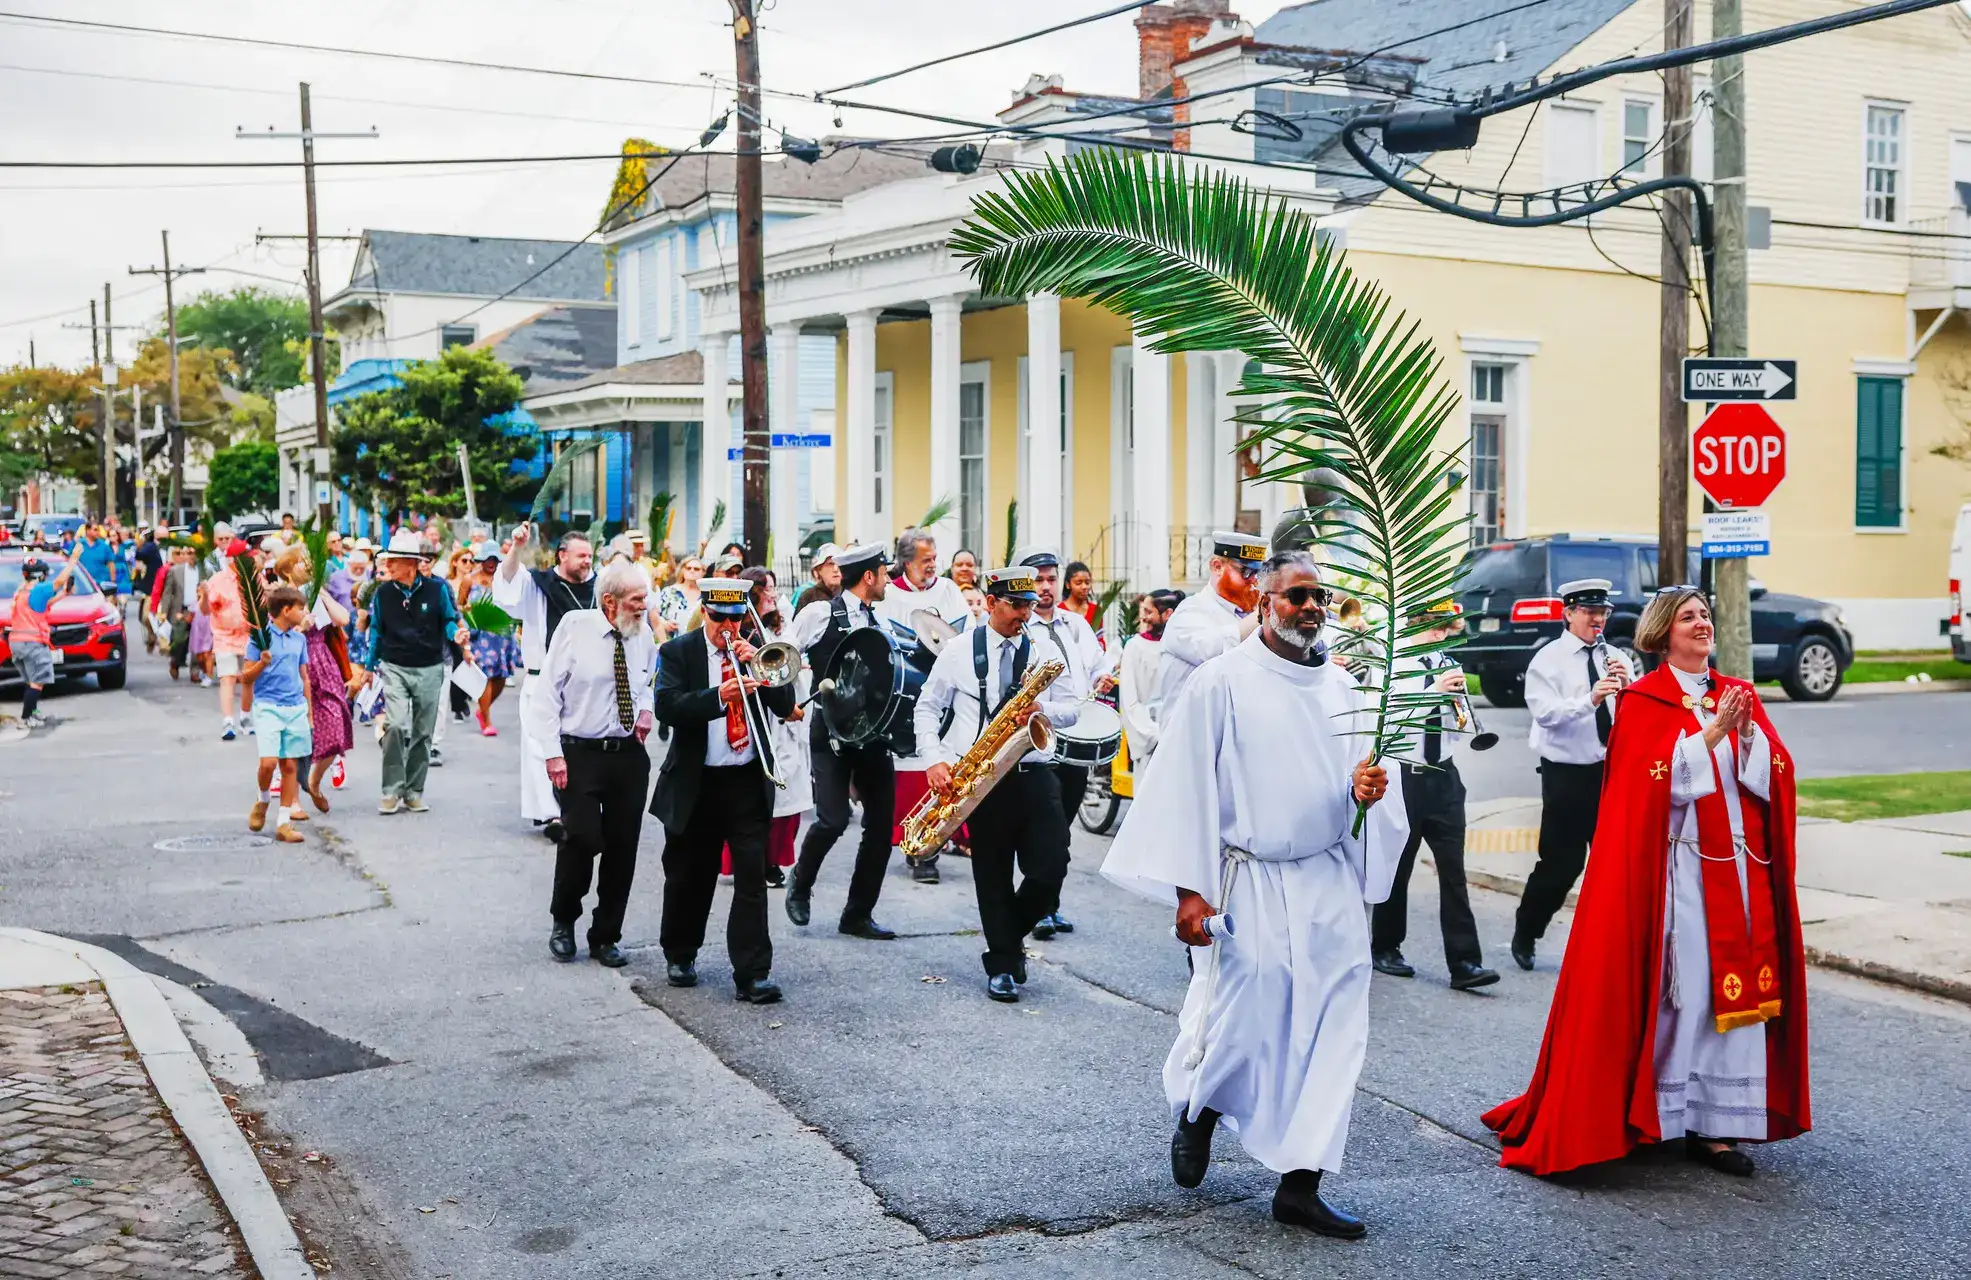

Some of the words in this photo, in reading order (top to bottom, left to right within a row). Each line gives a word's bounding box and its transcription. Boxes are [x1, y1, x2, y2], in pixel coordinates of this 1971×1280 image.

[1695, 373, 1725, 388] ONE
[1732, 373, 1762, 388] WAY
[1698, 435, 1781, 475] STOP
